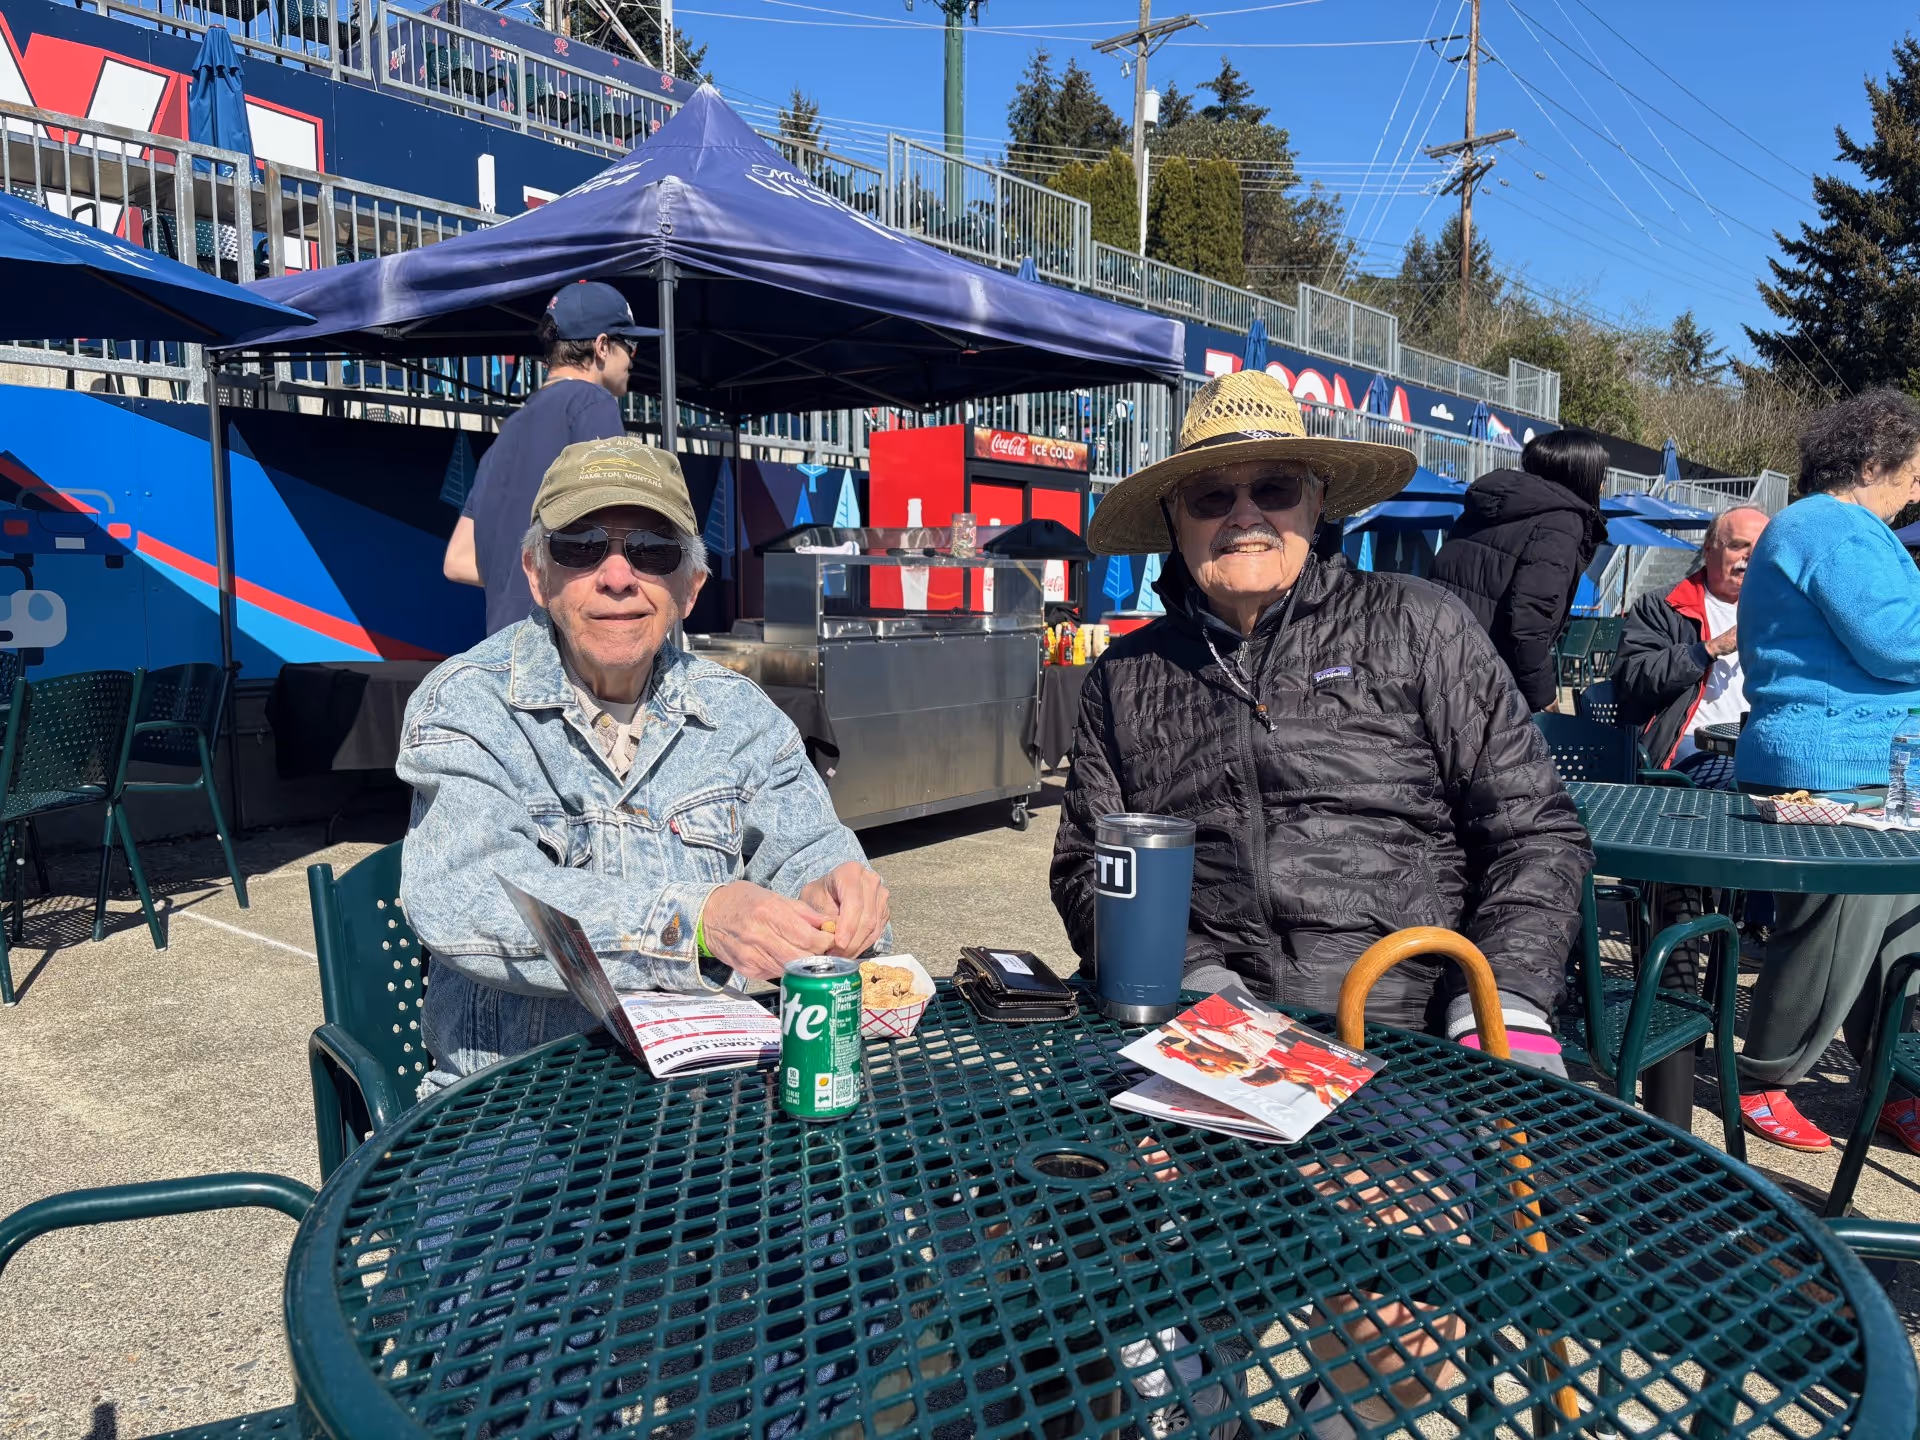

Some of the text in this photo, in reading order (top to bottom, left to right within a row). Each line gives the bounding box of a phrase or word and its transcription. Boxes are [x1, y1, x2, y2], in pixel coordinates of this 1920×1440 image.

[617, 440, 640, 449] AUTO
[1031, 444, 1047, 457] ICE
[1049, 446, 1075, 460] COLD
[625, 472, 663, 488] MONTANA
[1316, 671, 1348, 682] patagonia
[711, 1040, 755, 1049] COAST
[654, 1043, 710, 1066] LEAGUE
